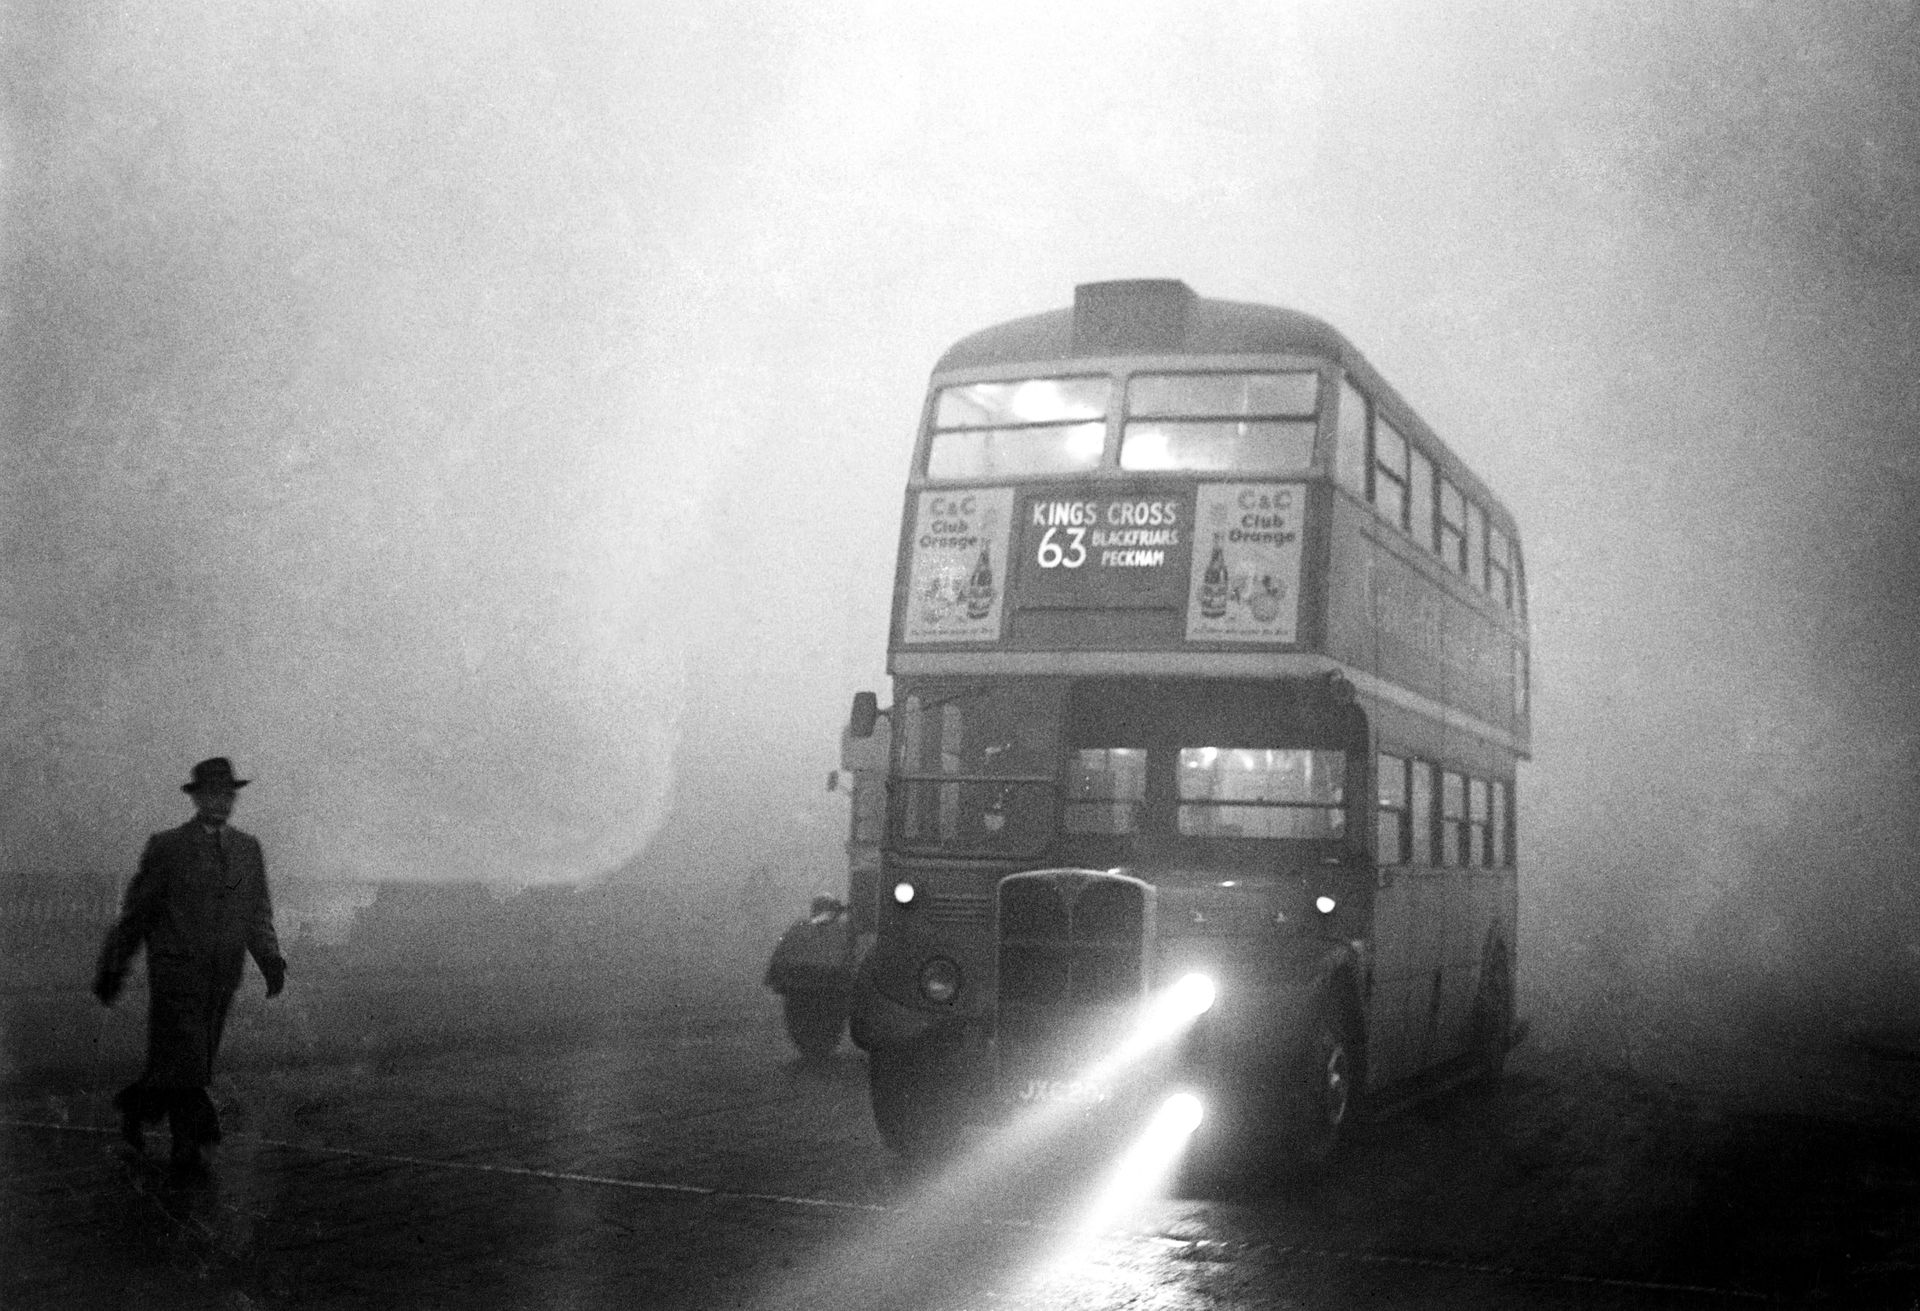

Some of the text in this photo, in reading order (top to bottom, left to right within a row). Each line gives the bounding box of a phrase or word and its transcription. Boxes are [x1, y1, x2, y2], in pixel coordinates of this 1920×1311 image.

[1033, 502, 1178, 525] KINGS CROSS
[1241, 514, 1284, 529] Club
[931, 520, 968, 534] Club
[919, 535, 978, 551] Orange
[1092, 529, 1179, 547] BLACKFRIARS
[1229, 528, 1296, 548] Orange
[1038, 527, 1086, 568] 63
[1101, 550, 1164, 567] PECKHAM
